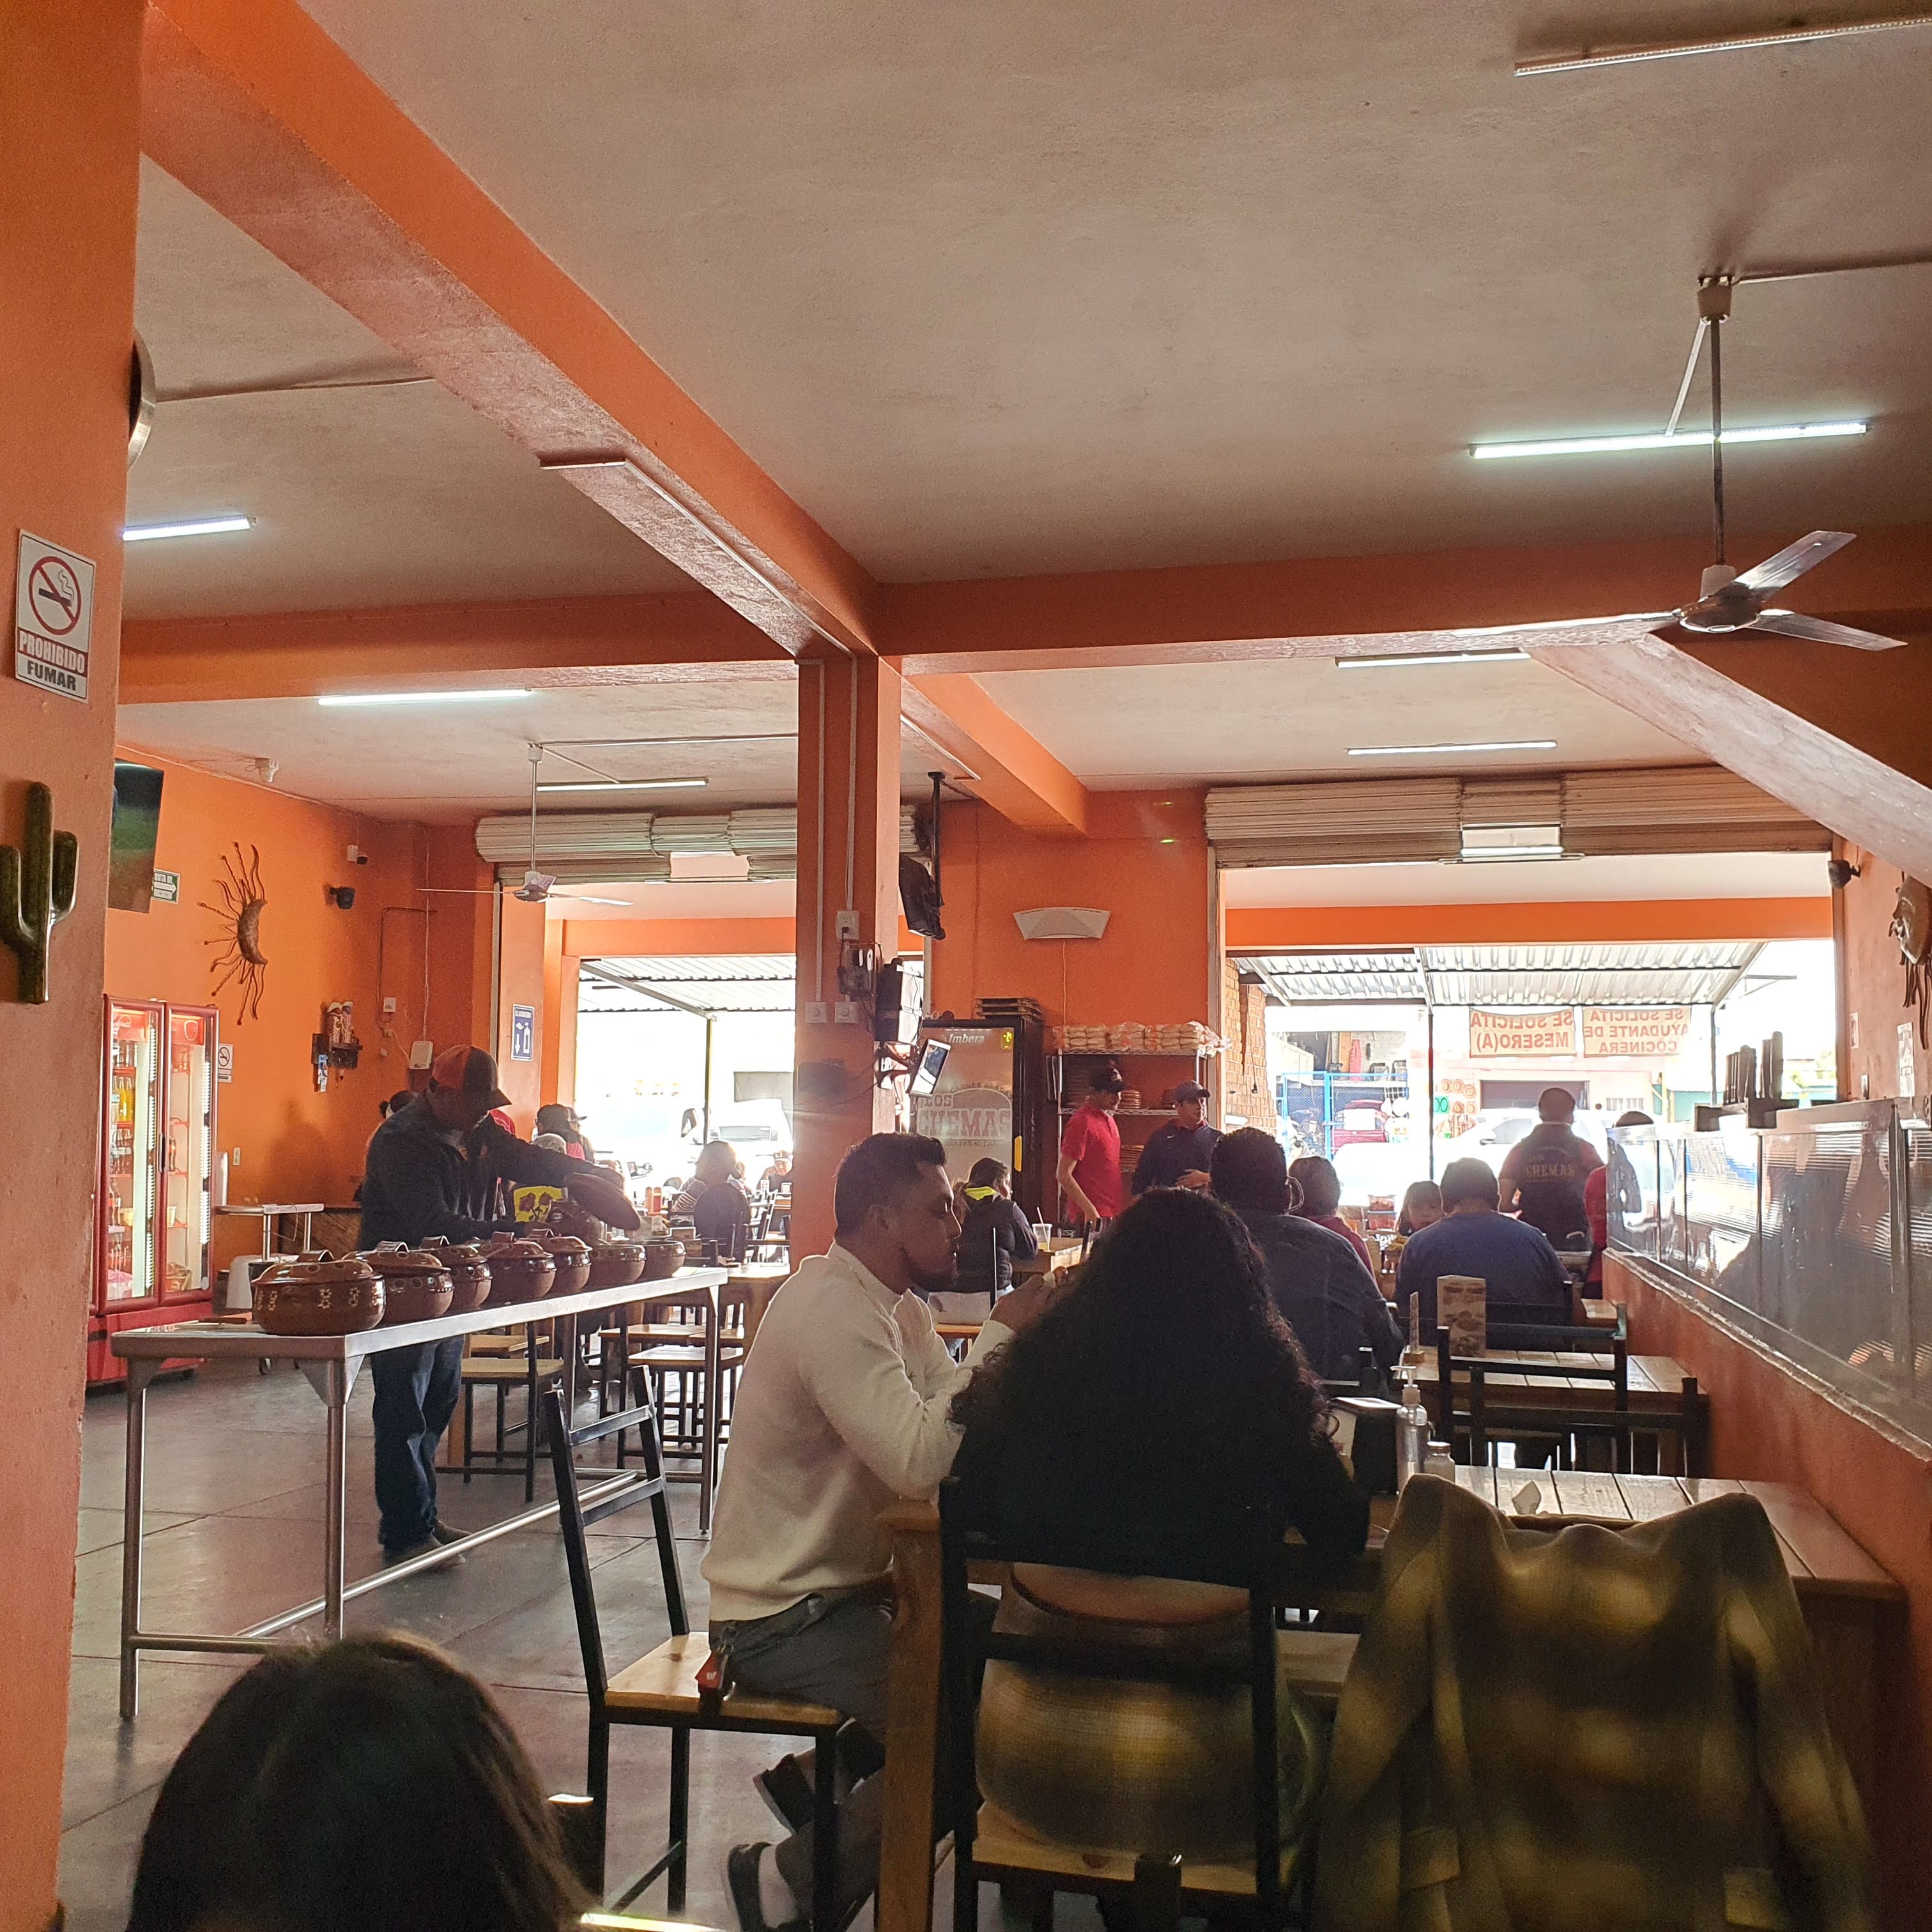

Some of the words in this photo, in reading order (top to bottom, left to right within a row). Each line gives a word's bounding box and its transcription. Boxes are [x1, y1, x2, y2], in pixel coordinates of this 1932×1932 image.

[19, 631, 85, 673] PROHIBIDO
[27, 660, 76, 691] FUMAR
[949, 1033, 985, 1043] Imbera
